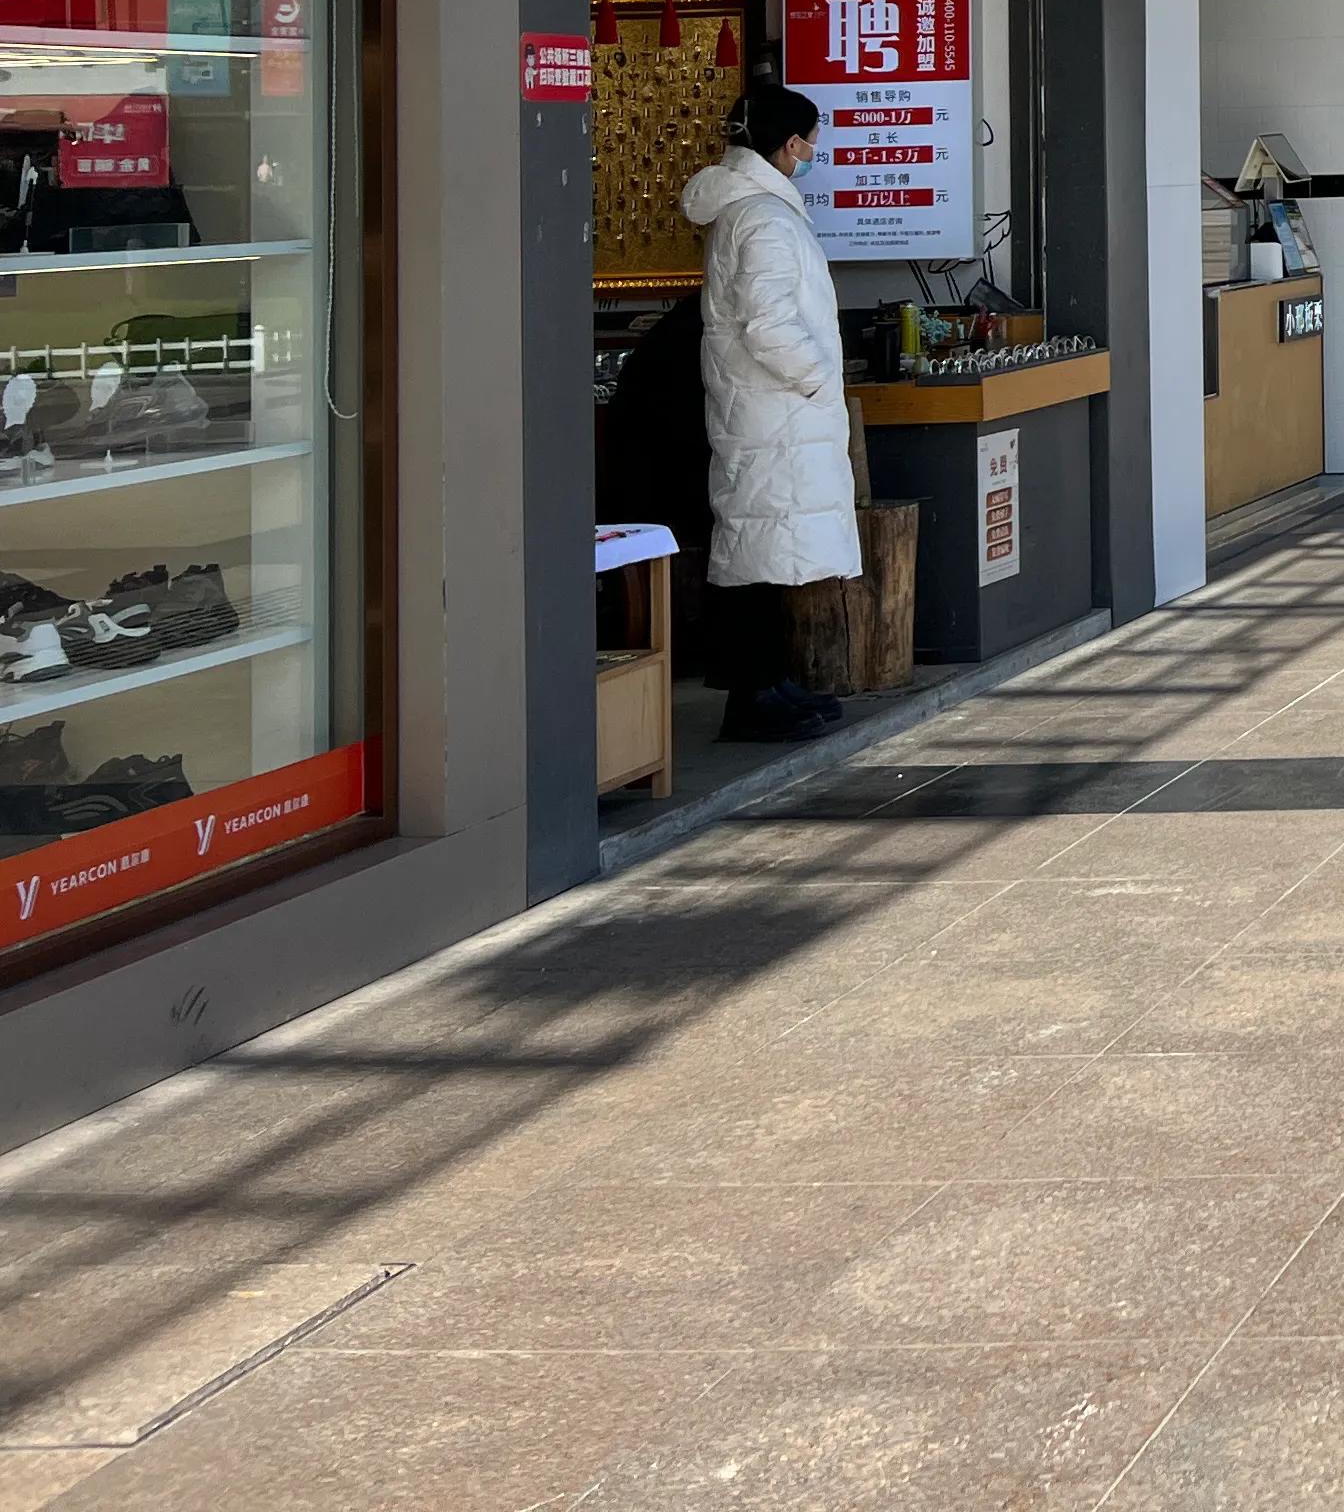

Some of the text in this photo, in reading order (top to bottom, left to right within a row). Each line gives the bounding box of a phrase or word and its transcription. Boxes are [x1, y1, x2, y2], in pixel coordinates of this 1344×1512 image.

[944, 0, 956, 71] 400-110-5545
[856, 90, 911, 103] 销售导购
[852, 109, 913, 125] 5000-1万
[935, 108, 949, 121] 元
[847, 148, 920, 165] 9千-1.5万
[935, 148, 949, 161] 元
[855, 173, 910, 187] 加工师傅
[857, 191, 911, 207] 1万以上
[935, 190, 949, 203] 元
[224, 806, 281, 834] YEARCON
[51, 862, 117, 896] YEARCON
